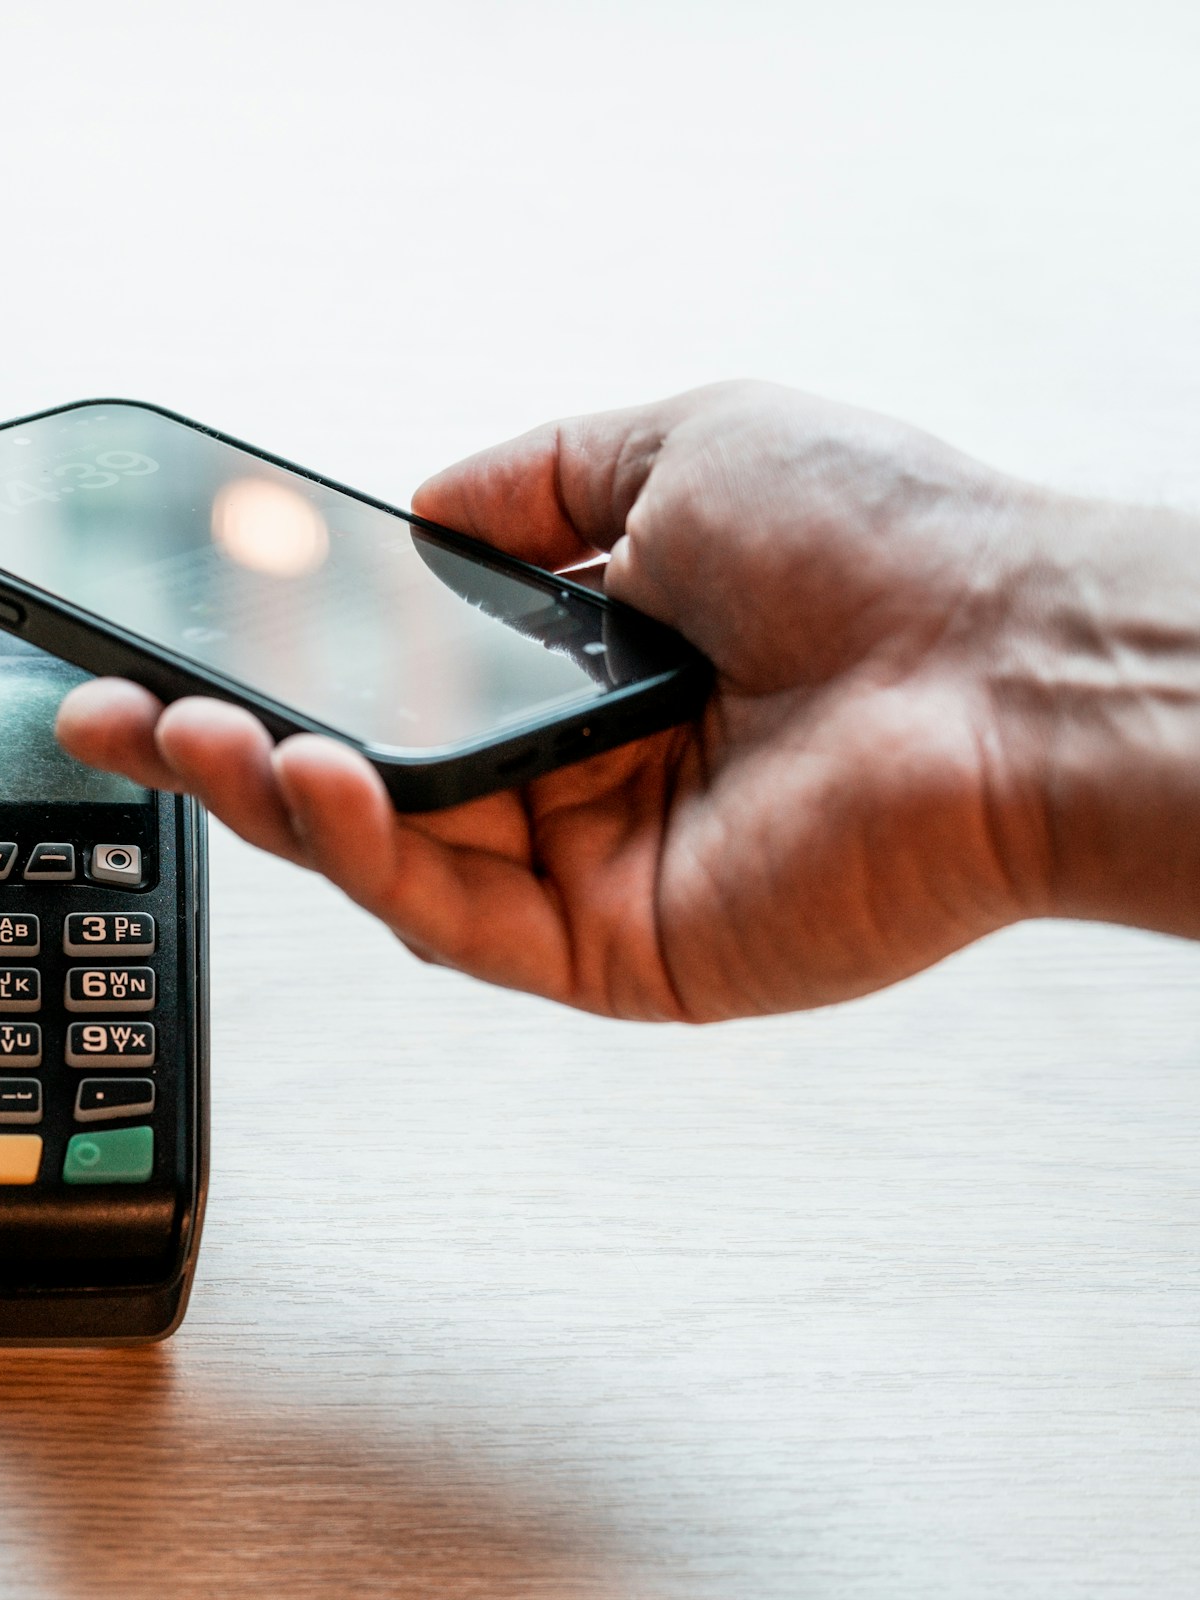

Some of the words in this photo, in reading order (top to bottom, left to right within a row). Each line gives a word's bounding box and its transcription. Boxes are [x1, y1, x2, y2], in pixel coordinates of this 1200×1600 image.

[83, 917, 106, 940] 3
[83, 972, 106, 996] 6
[83, 1026, 107, 1051] 9
